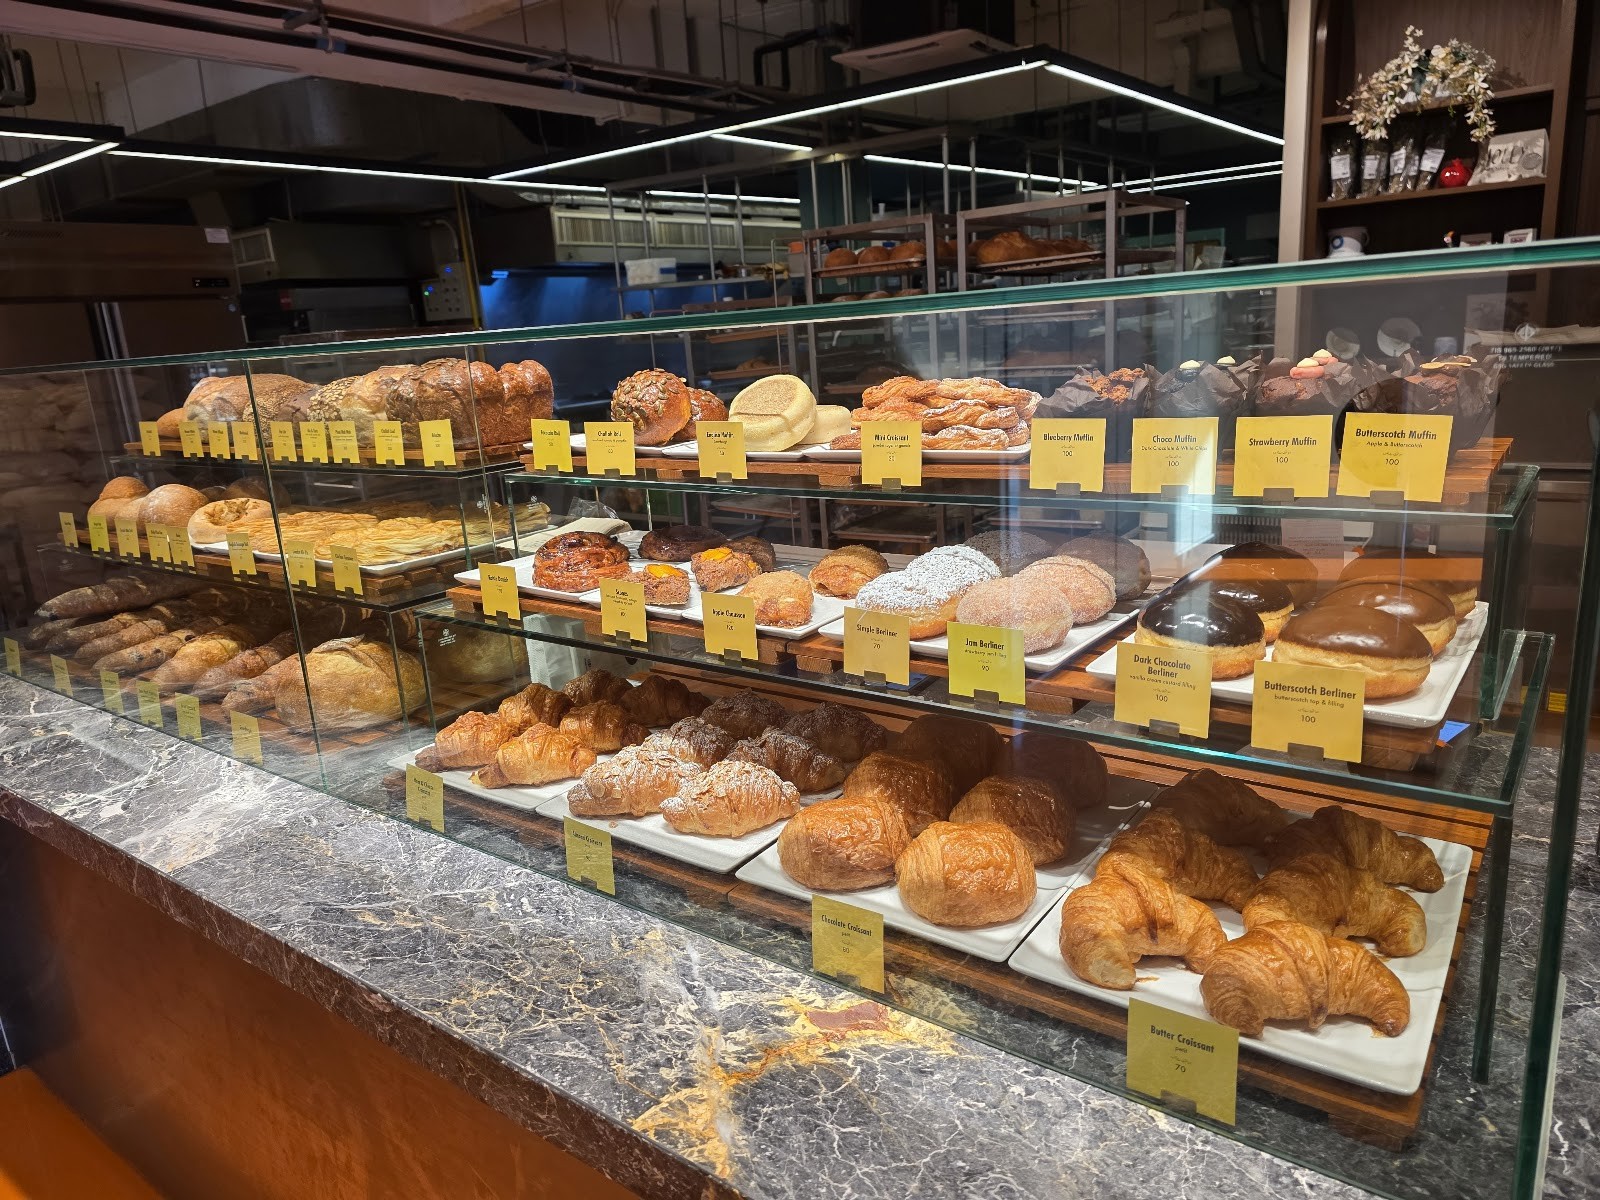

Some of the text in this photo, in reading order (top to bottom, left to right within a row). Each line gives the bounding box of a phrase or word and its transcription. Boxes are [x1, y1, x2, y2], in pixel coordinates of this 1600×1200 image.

[1043, 432, 1094, 442] Blueberry Muffin
[1152, 434, 1197, 443] Choco Muffin
[1356, 428, 1437, 440] Butterscotch Muffin
[1249, 436, 1317, 447] Strawberry Muffin
[856, 624, 898, 637] Simple Berliner
[965, 638, 1005, 650] Jam Berliner
[1134, 654, 1191, 670] Dark Chocolate
[1148, 666, 1178, 678] Berliner
[1264, 680, 1356, 700] Butterscotch Berliner
[1156, 694, 1168, 702] 100
[1274, 694, 1309, 703] butterscotch
[1310, 698, 1320, 706] top
[1301, 714, 1316, 723] 100
[821, 914, 872, 937] Chocolate Croissant
[1150, 1025, 1215, 1053] Butter Croissant
[1175, 1063, 1186, 1073] 70
